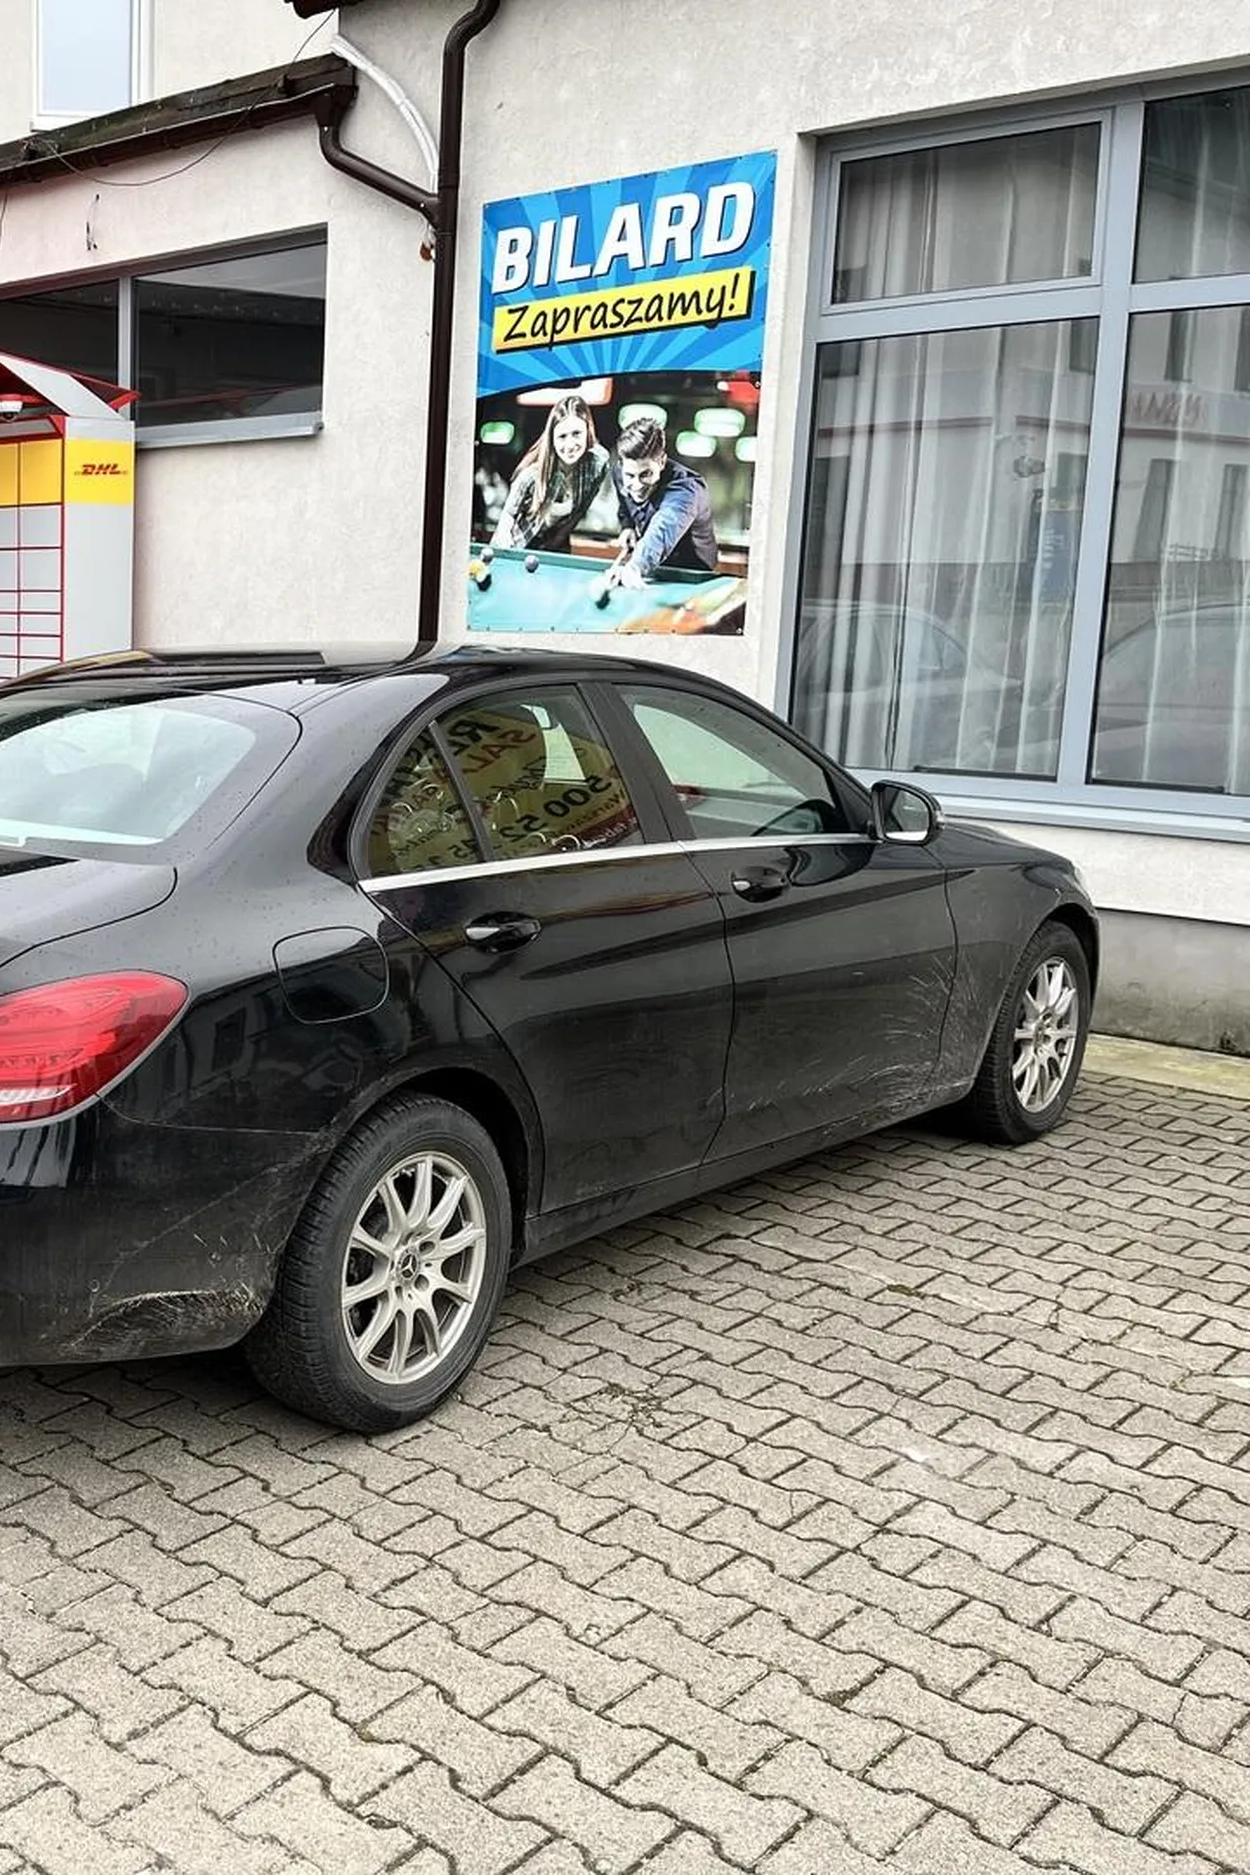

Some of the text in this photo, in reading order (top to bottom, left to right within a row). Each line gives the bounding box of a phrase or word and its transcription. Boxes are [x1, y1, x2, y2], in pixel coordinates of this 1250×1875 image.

[491, 181, 756, 295] BILARD
[503, 273, 740, 351] Zapraszamy!
[81, 463, 121, 475] DHL
